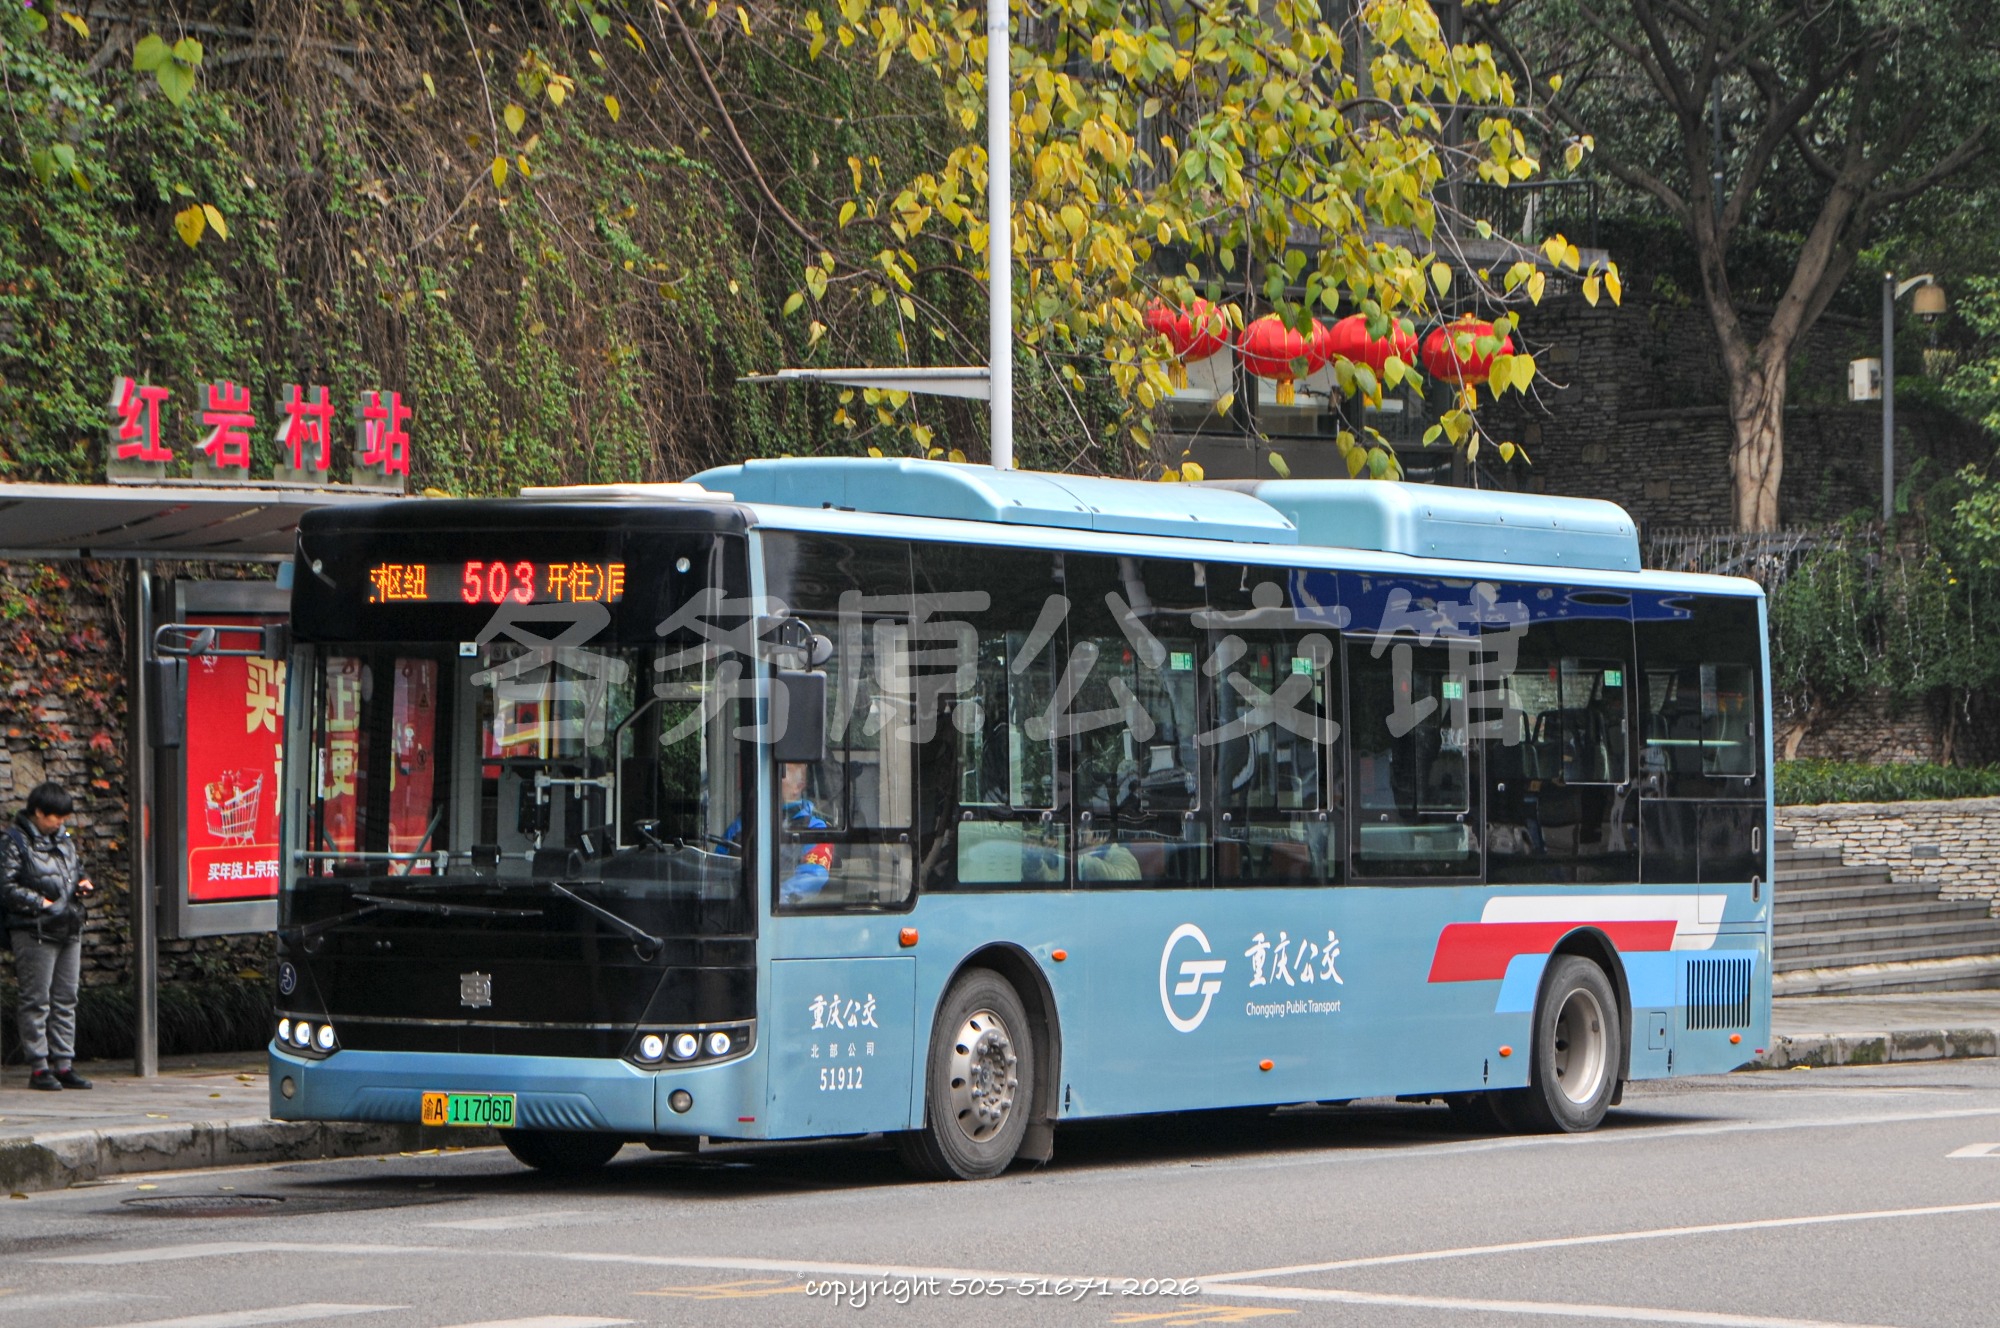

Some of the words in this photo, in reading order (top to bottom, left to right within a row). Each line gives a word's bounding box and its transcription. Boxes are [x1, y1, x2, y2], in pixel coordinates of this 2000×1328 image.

[111, 376, 412, 477] 红岩村站
[370, 562, 428, 603] 枢纽
[462, 561, 535, 604] 503
[208, 860, 280, 881] 买年货上京东
[1244, 930, 1344, 988] 重庆公交
[808, 993, 879, 1030] 重庆公交
[1246, 1001, 1285, 1018] Chongqing
[1286, 1000, 1307, 1015] Public
[1308, 999, 1341, 1015] Transport
[811, 1041, 875, 1059] 北部公司
[820, 1066, 863, 1091] 51912
